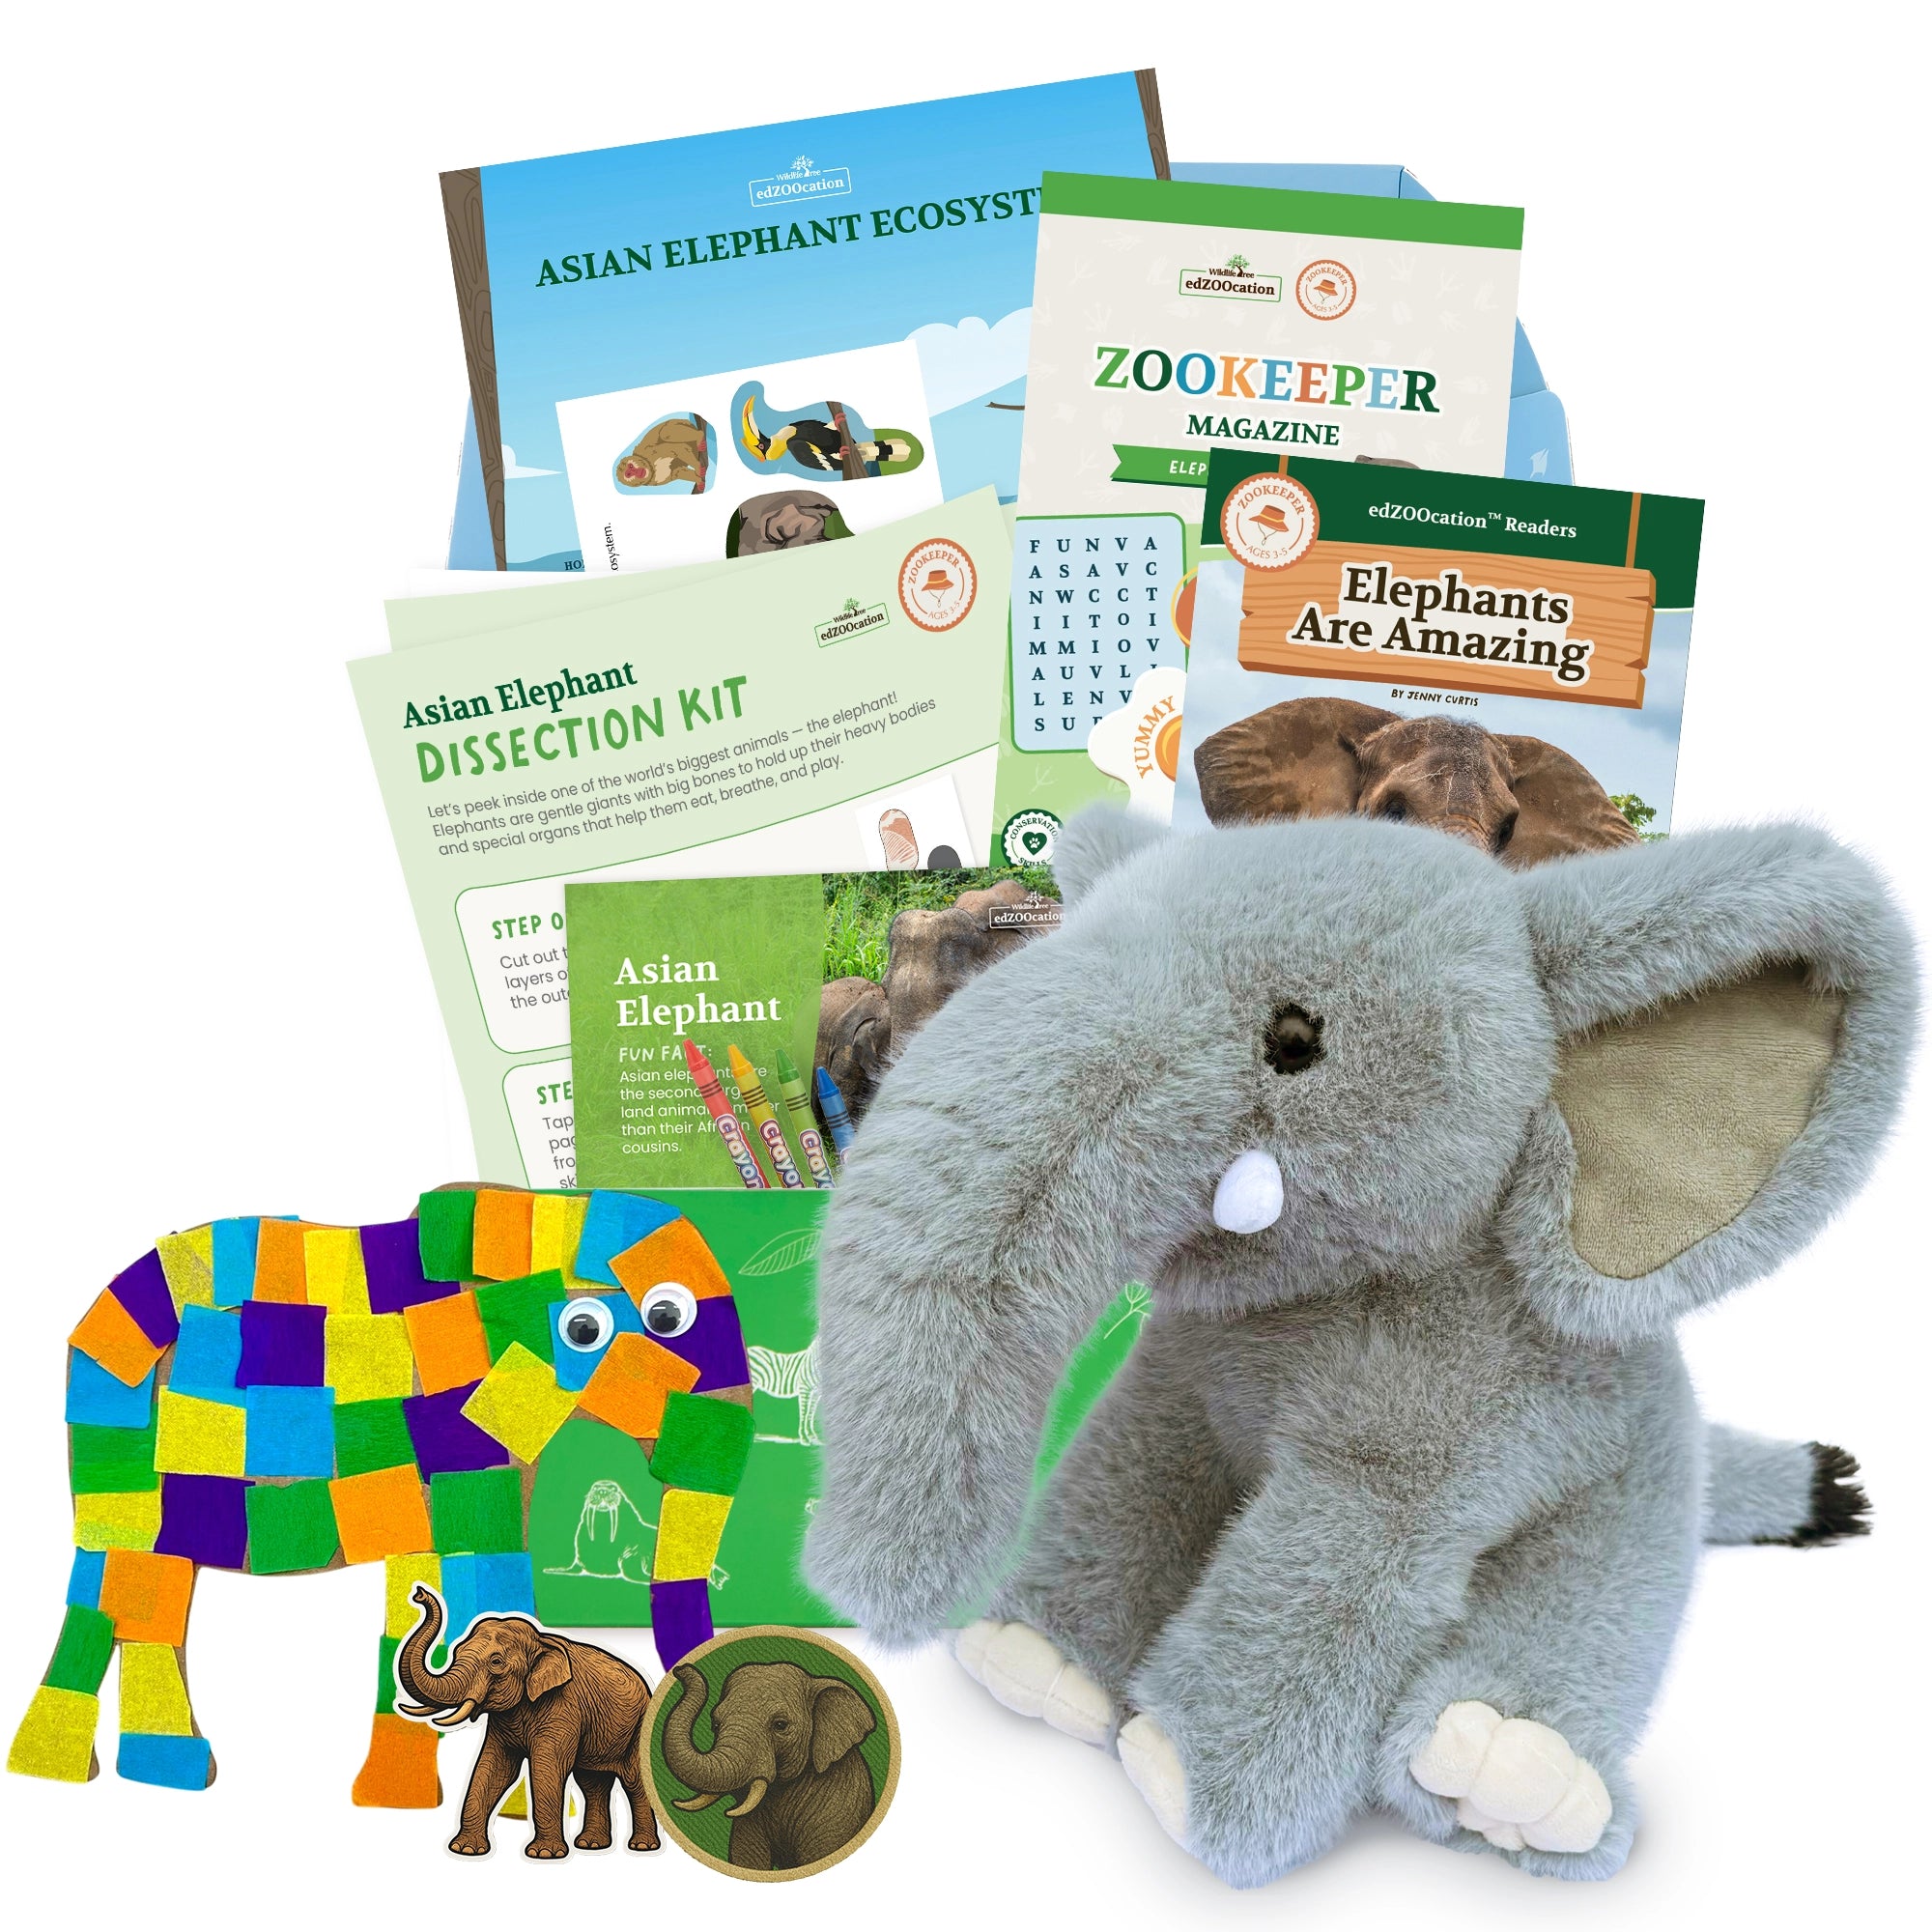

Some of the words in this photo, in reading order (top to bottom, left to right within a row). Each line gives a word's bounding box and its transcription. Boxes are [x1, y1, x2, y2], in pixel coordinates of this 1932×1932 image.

[776, 171, 803, 182] Wildlife
[756, 177, 844, 200] edZOOcation
[535, 244, 652, 287] ASIAN
[662, 213, 862, 269] ELEPHANT
[870, 186, 1042, 238] ECOSYST
[1208, 268, 1236, 278] Wildlife
[1306, 267, 1348, 286] ZOOKEEPER
[1185, 277, 1275, 296] edZOOcation
[1094, 346, 1440, 413] ZOOKEEPER
[1186, 414, 1340, 445] MAGAZINE
[1237, 485, 1305, 515] ZOOKEEPER
[1504, 516, 1577, 538] Readers
[1030, 540, 1039, 553] F
[1057, 539, 1070, 552] U
[1086, 538, 1099, 552] N
[1115, 538, 1127, 551] V
[1144, 537, 1157, 550] A
[1246, 545, 1270, 559] AGES
[1274, 548, 1288, 559] 3-5
[908, 550, 960, 584] ZOOKEEPER
[1029, 566, 1042, 579] A
[1060, 565, 1069, 578] S
[1087, 564, 1099, 577] A
[1116, 563, 1128, 576] V
[1146, 562, 1156, 575] C
[1029, 591, 1043, 604] N
[1056, 590, 1074, 603] W
[1089, 589, 1099, 602] C
[1118, 588, 1128, 602] C
[1146, 587, 1157, 601] T
[1344, 566, 1569, 624] Elephants
[833, 612, 854, 624] Wildlife
[928, 610, 949, 619] AGES
[1034, 616, 1040, 629] I
[1063, 615, 1069, 628] I
[1089, 614, 1100, 628] T
[1118, 613, 1129, 625] O
[1150, 613, 1155, 626] I
[820, 611, 885, 641] edZOOcation
[1029, 641, 1046, 655] M
[1058, 640, 1075, 654] M
[1092, 640, 1098, 653] I
[1118, 639, 1130, 652] O
[1147, 639, 1159, 651] V
[1291, 607, 1373, 647] Are
[1381, 616, 1590, 682] Amazing
[1032, 668, 1045, 680] A
[1061, 667, 1074, 679] U
[1090, 666, 1102, 678] V
[1121, 666, 1130, 677] L
[403, 695, 494, 729] Asian
[495, 662, 638, 713] Elephant
[1034, 693, 1044, 705] L
[1063, 692, 1073, 704] E
[1090, 691, 1103, 704] N
[1120, 691, 1132, 703] V
[1391, 689, 1405, 698] BY
[1406, 691, 1442, 703] JENNY
[1445, 695, 1479, 707] CURTIS
[415, 696, 665, 783] DISSECTION
[678, 675, 747, 731] KIT
[1036, 718, 1044, 731] S
[1062, 718, 1075, 730] U
[1134, 696, 1176, 780] YUMMY
[464, 796, 502, 821] peek
[503, 789, 547, 809] inside
[551, 785, 579, 801] one
[581, 778, 596, 795] of
[597, 775, 623, 791] the
[676, 746, 731, 774] biggest
[732, 730, 789, 757] animals
[806, 717, 830, 734] the
[833, 691, 898, 725] elephant!
[433, 814, 507, 838] Elephants
[510, 810, 534, 827] are
[537, 802, 583, 831] gentle
[586, 792, 632, 818] giants
[634, 784, 665, 803] with
[667, 778, 691, 799] big
[692, 769, 737, 789] bones
[738, 761, 753, 776] to
[755, 751, 787, 771] hold
[789, 743, 810, 763] up
[810, 731, 842, 753] their
[844, 717, 887, 742] heavy
[889, 698, 937, 724] bodies
[439, 839, 470, 856] and
[472, 831, 526, 856] special
[528, 824, 582, 845] organs
[582, 816, 614, 834] that
[615, 808, 647, 832] help
[649, 799, 689, 818] them
[690, 790, 719, 809] eat,
[719, 777, 779, 801] breathe,
[780, 763, 809, 783] and
[810, 752, 845, 778] play.
[492, 915, 542, 940] STEP
[499, 952, 530, 970] Cut
[533, 948, 560, 964] out
[613, 954, 720, 985] Asian
[504, 972, 554, 992] layers
[557, 968, 569, 980] o
[510, 994, 538, 1009] the
[616, 993, 782, 1037] Elephant
[619, 1047, 655, 1063] FUN
[662, 1044, 712, 1061] FAT:
[619, 1069, 661, 1083] Asian
[536, 1081, 573, 1105] STE
[620, 1088, 644, 1100] the
[621, 1105, 654, 1118] land
[658, 1102, 710, 1116] anima
[542, 1116, 574, 1131] Tap
[621, 1123, 656, 1136] than
[659, 1121, 694, 1135] their
[622, 1140, 682, 1154] cousins.
[759, 1119, 805, 1188] Crayo
[554, 1155, 577, 1170] fro
[559, 1173, 578, 1189] sk
